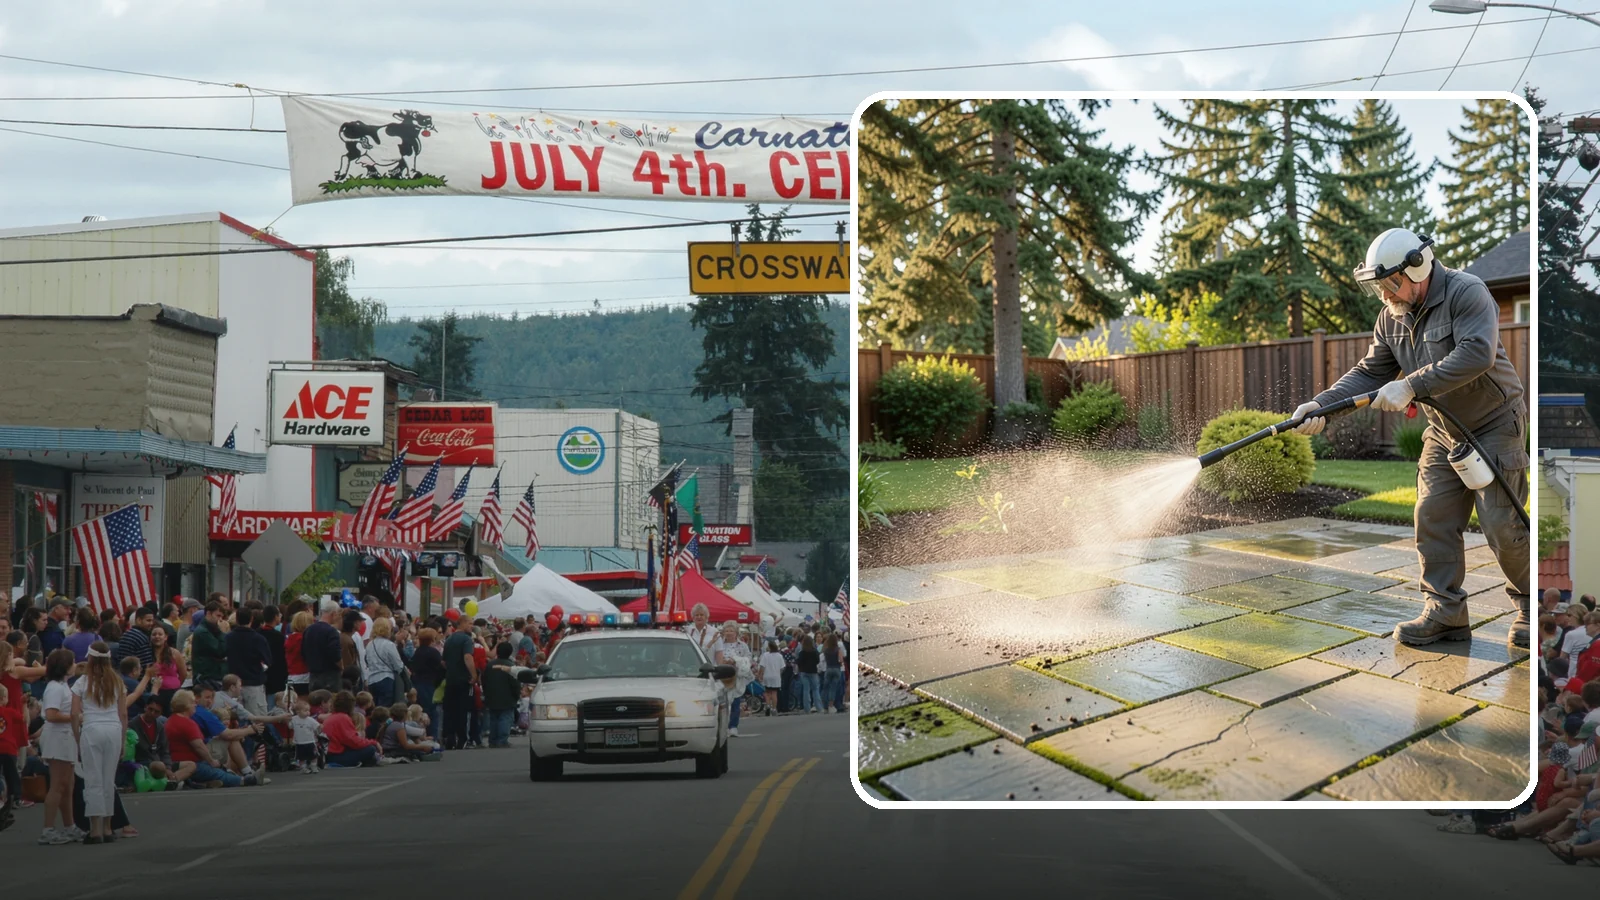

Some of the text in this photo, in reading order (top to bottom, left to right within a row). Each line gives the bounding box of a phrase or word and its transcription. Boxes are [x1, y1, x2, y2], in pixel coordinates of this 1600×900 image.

[481, 141, 604, 192] JULY
[632, 150, 747, 197] 4th.
[697, 255, 850, 279] CROSSWA
[282, 380, 373, 420] ACE
[405, 410, 485, 422] CEDAR LOG
[283, 421, 371, 436] Hardware
[96, 486, 124, 494] Vincent
[126, 486, 135, 495] de
[138, 486, 155, 495] Paul
[212, 516, 330, 536] HARDARE
[688, 526, 741, 535] CRNATION
[699, 535, 730, 543] GLASS
